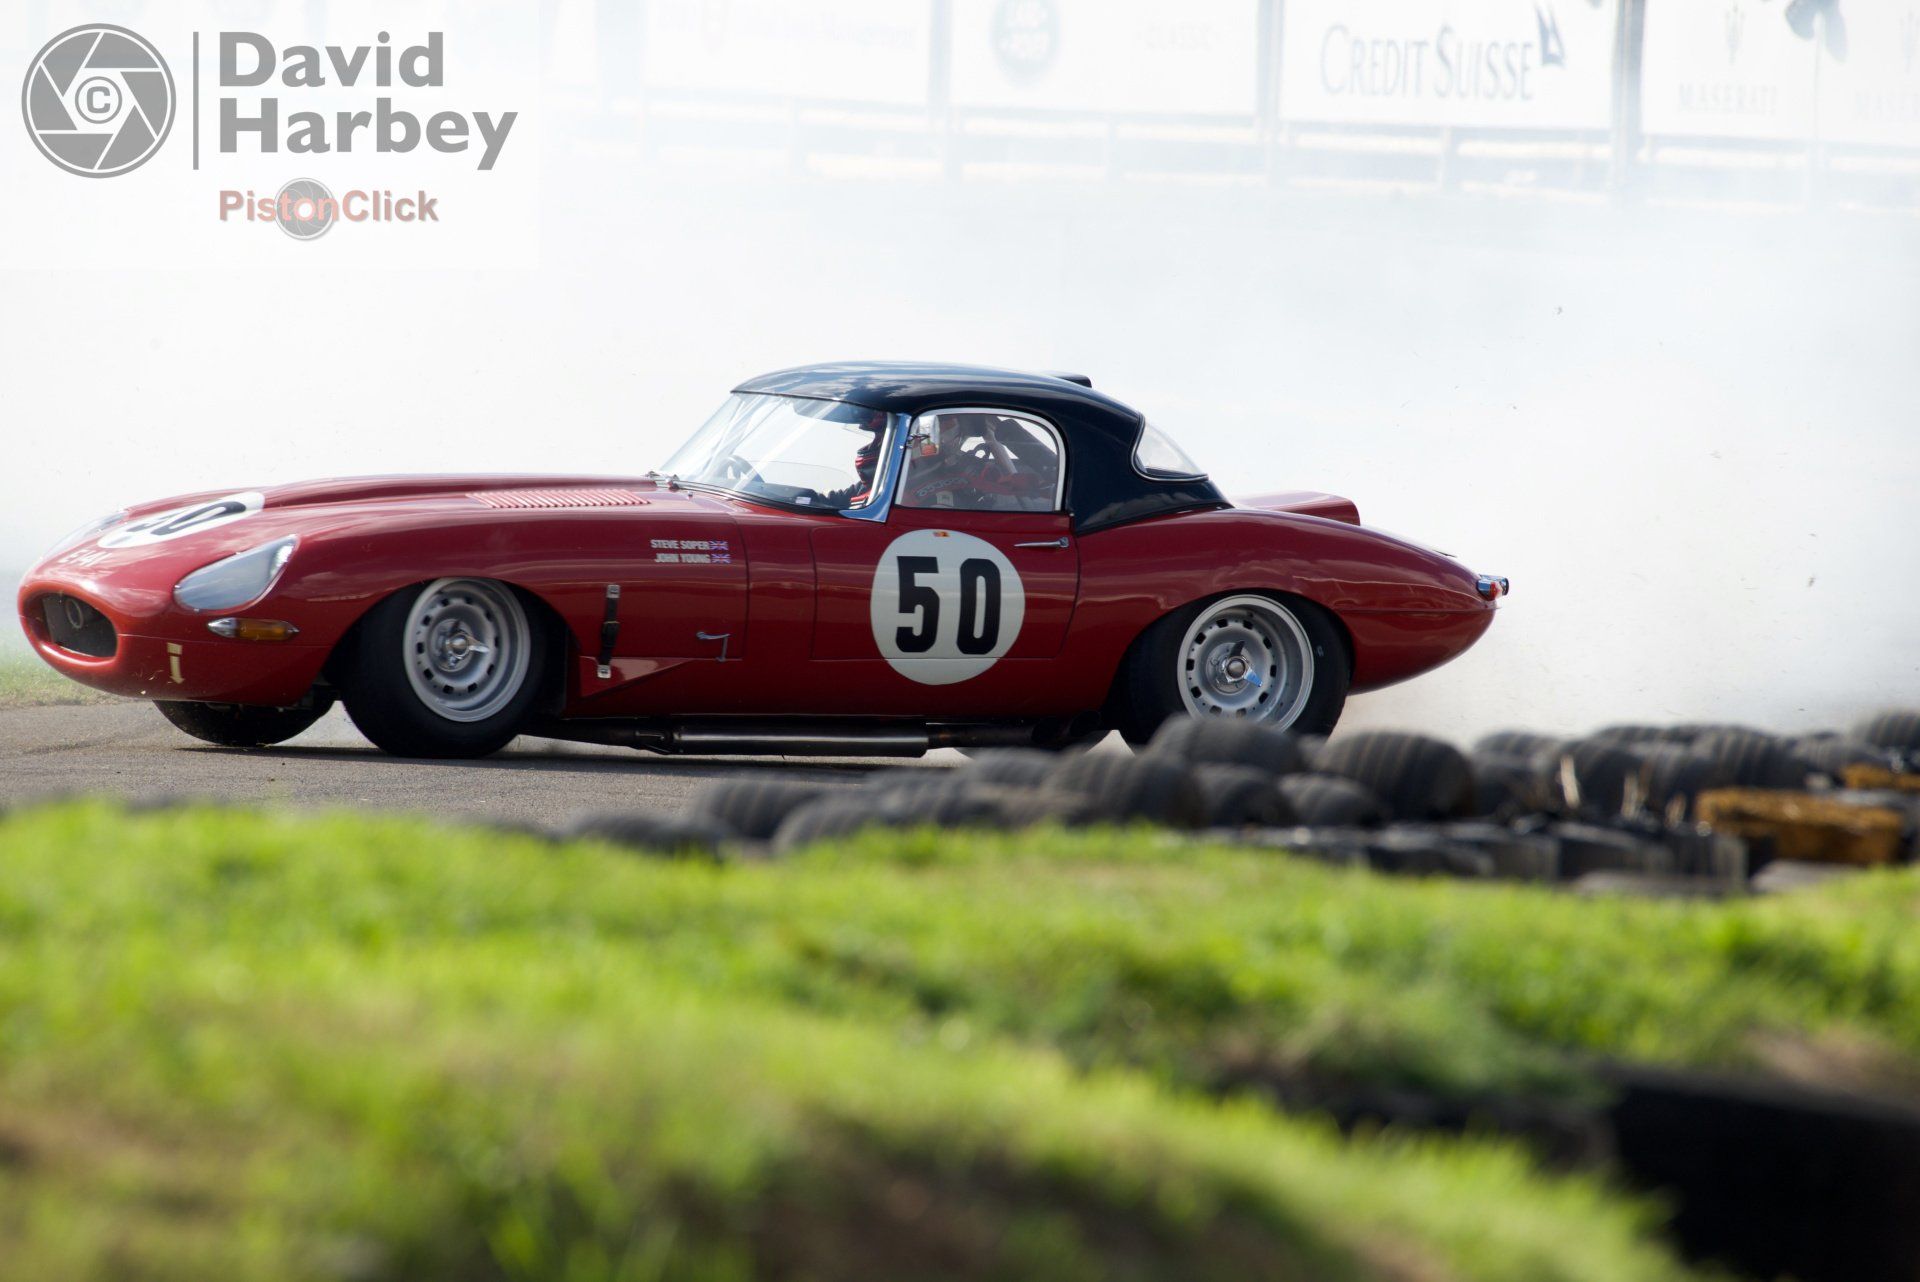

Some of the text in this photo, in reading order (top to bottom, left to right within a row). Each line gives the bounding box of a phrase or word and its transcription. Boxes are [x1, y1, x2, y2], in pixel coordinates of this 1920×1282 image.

[1320, 20, 1534, 101] CREDIT SUISSE
[650, 539, 710, 550] STEVE SOPER
[654, 553, 711, 564] JOHN YOUNG
[895, 556, 1001, 655] 50
